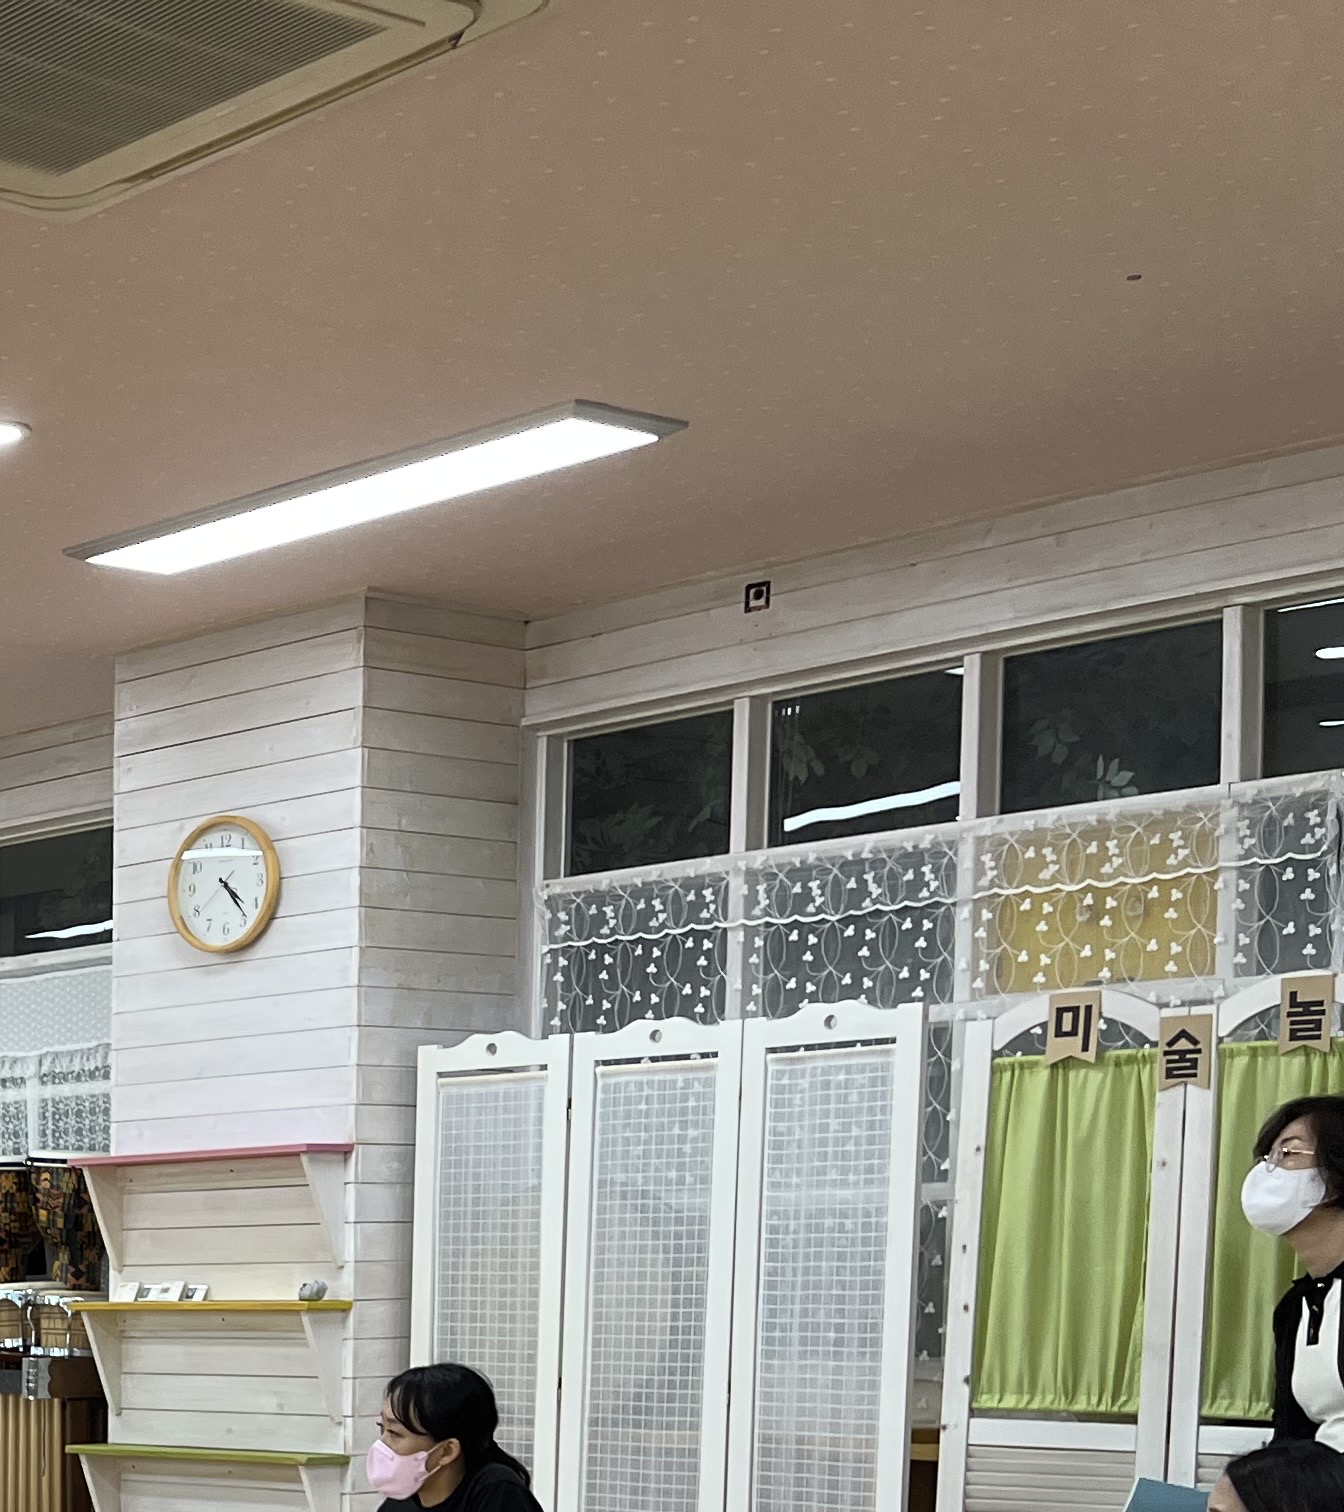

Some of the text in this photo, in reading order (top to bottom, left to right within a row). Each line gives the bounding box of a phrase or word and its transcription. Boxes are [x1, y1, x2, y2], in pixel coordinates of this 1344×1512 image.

[220, 834, 232, 848] 12
[192, 861, 202, 875] 10
[256, 873, 264, 887] 3
[188, 884, 196, 898] 9
[193, 904, 201, 918] 8
[206, 918, 213, 932] 7
[222, 922, 230, 935] 6
